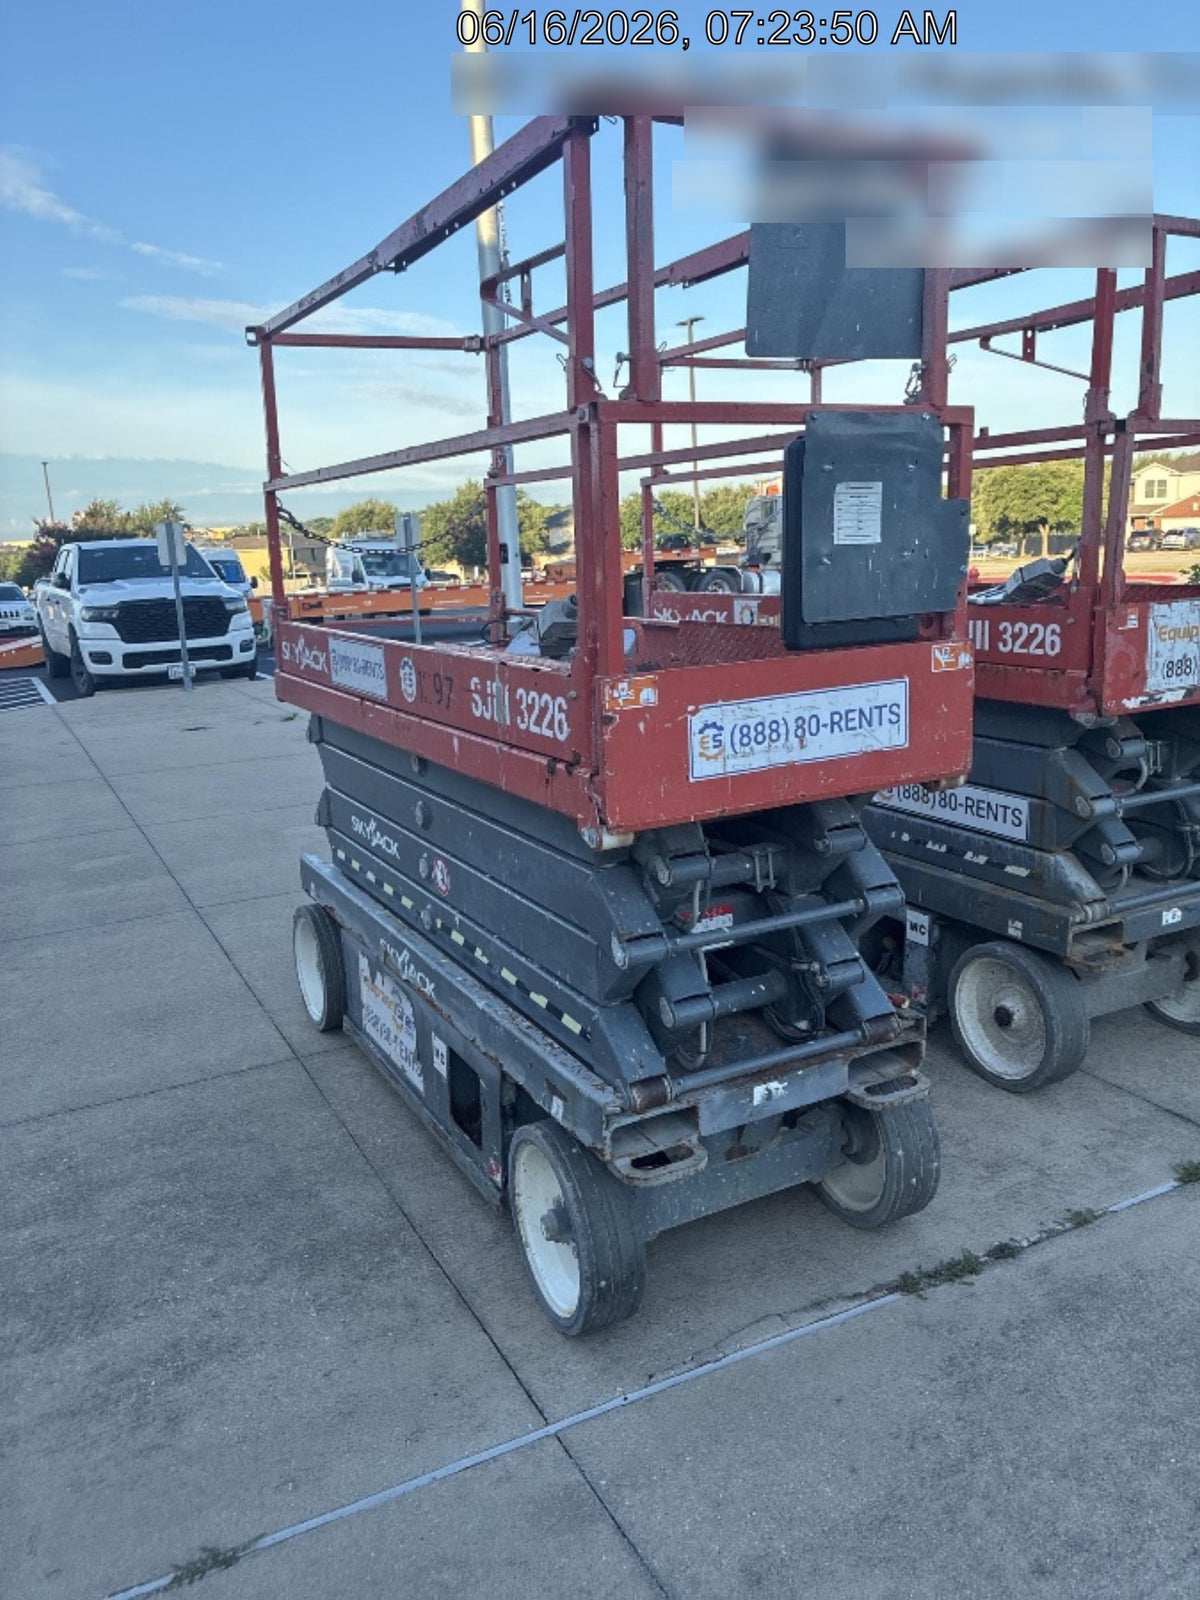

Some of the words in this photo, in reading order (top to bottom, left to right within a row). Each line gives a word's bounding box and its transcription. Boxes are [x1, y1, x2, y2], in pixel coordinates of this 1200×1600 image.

[998, 621, 1061, 656] 3226
[1162, 656, 1198, 680] (888)
[515, 687, 568, 742] 3226
[730, 716, 789, 754] (888)
[794, 703, 901, 739] 80-RENTS
[938, 790, 1024, 828] 80-RENTS
